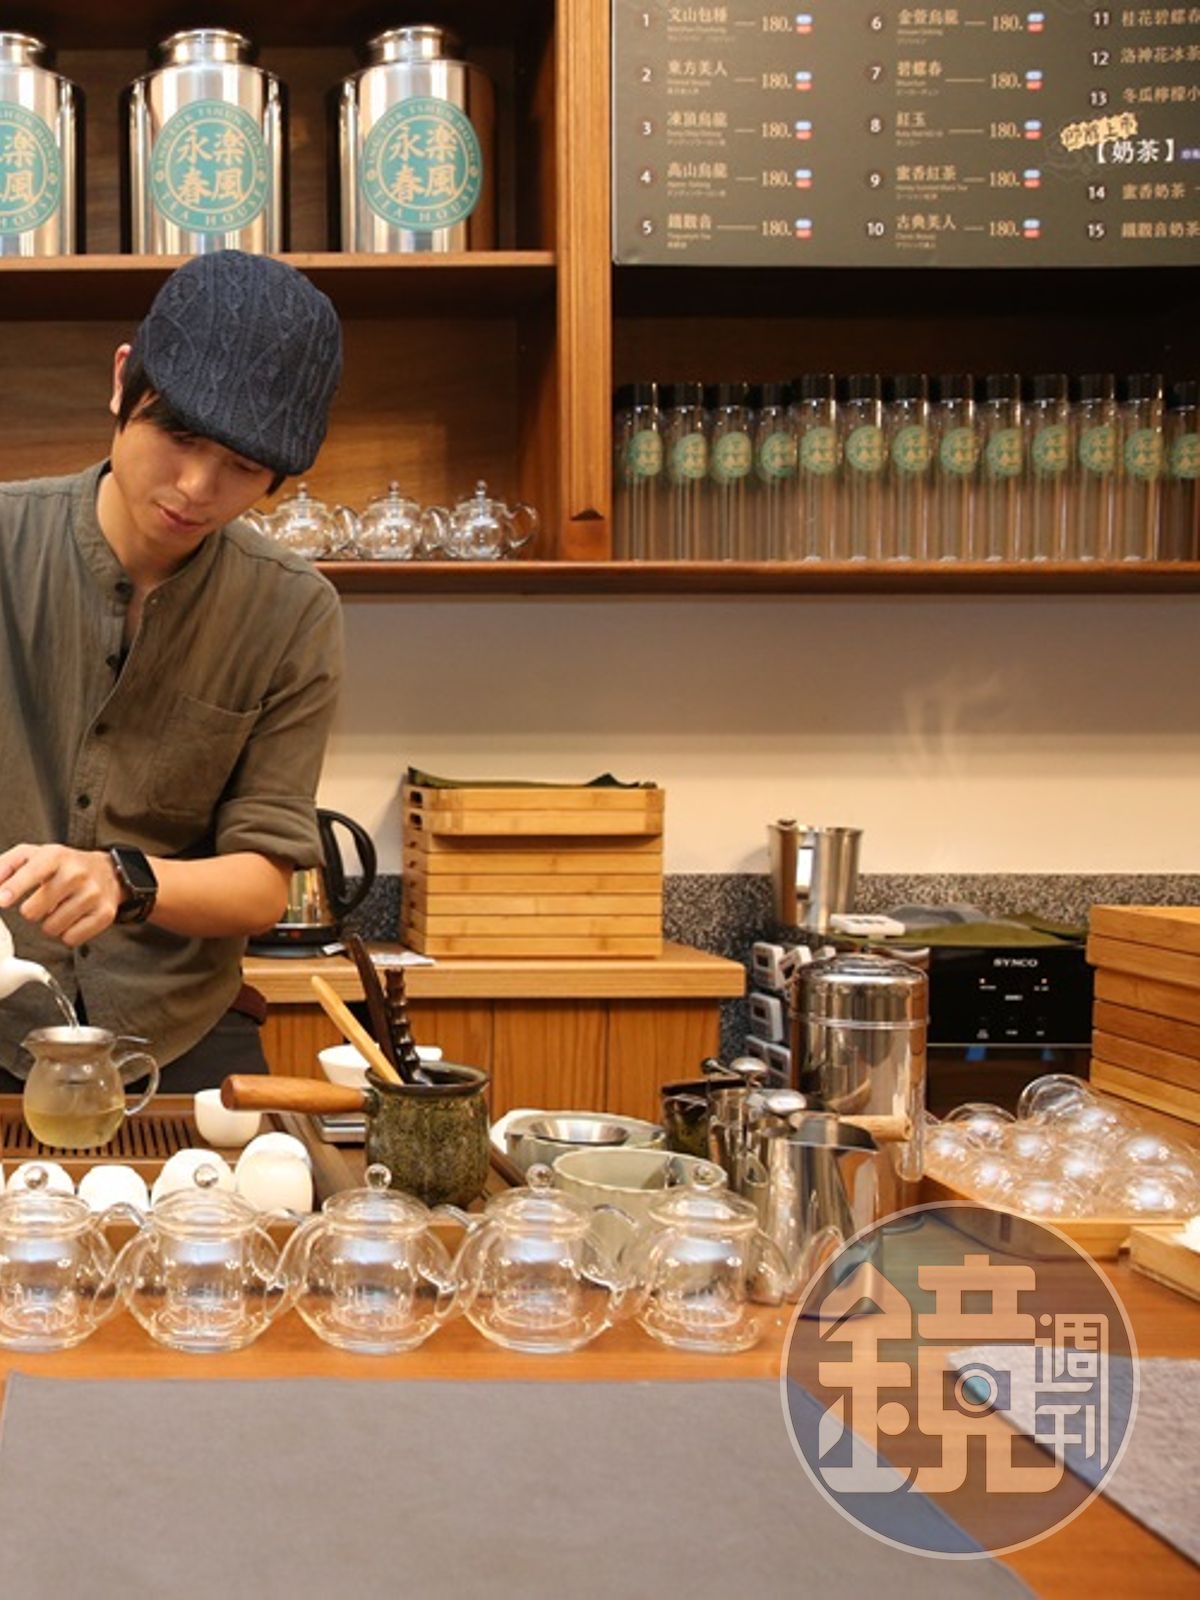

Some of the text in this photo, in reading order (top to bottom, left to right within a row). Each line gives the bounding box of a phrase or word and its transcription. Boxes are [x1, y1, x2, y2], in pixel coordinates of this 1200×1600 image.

[642, 13, 650, 27] 1
[871, 16, 882, 30] 6
[1094, 11, 1109, 26] 11
[1092, 51, 1110, 66] 12
[641, 68, 651, 83] 2
[668, 59, 728, 77] 東方美人
[871, 66, 882, 80] 7
[897, 60, 943, 77] 碧螺春
[1090, 91, 1108, 106] 13
[642, 122, 651, 135] 3
[870, 118, 881, 133] 8
[896, 111, 926, 128] 紅玉
[640, 170, 651, 184] 4
[667, 162, 728, 179] 高山烏龍
[870, 173, 881, 188] 9
[896, 165, 957, 181] 蜜香紅茶
[1088, 186, 1105, 199] 14
[161, 190, 262, 226] TEA HOUSE
[374, 189, 403, 218] TEA
[642, 220, 652, 234] 5
[867, 222, 884, 236] 10
[896, 213, 956, 231] 古典美人
[1088, 223, 1105, 237] 15
